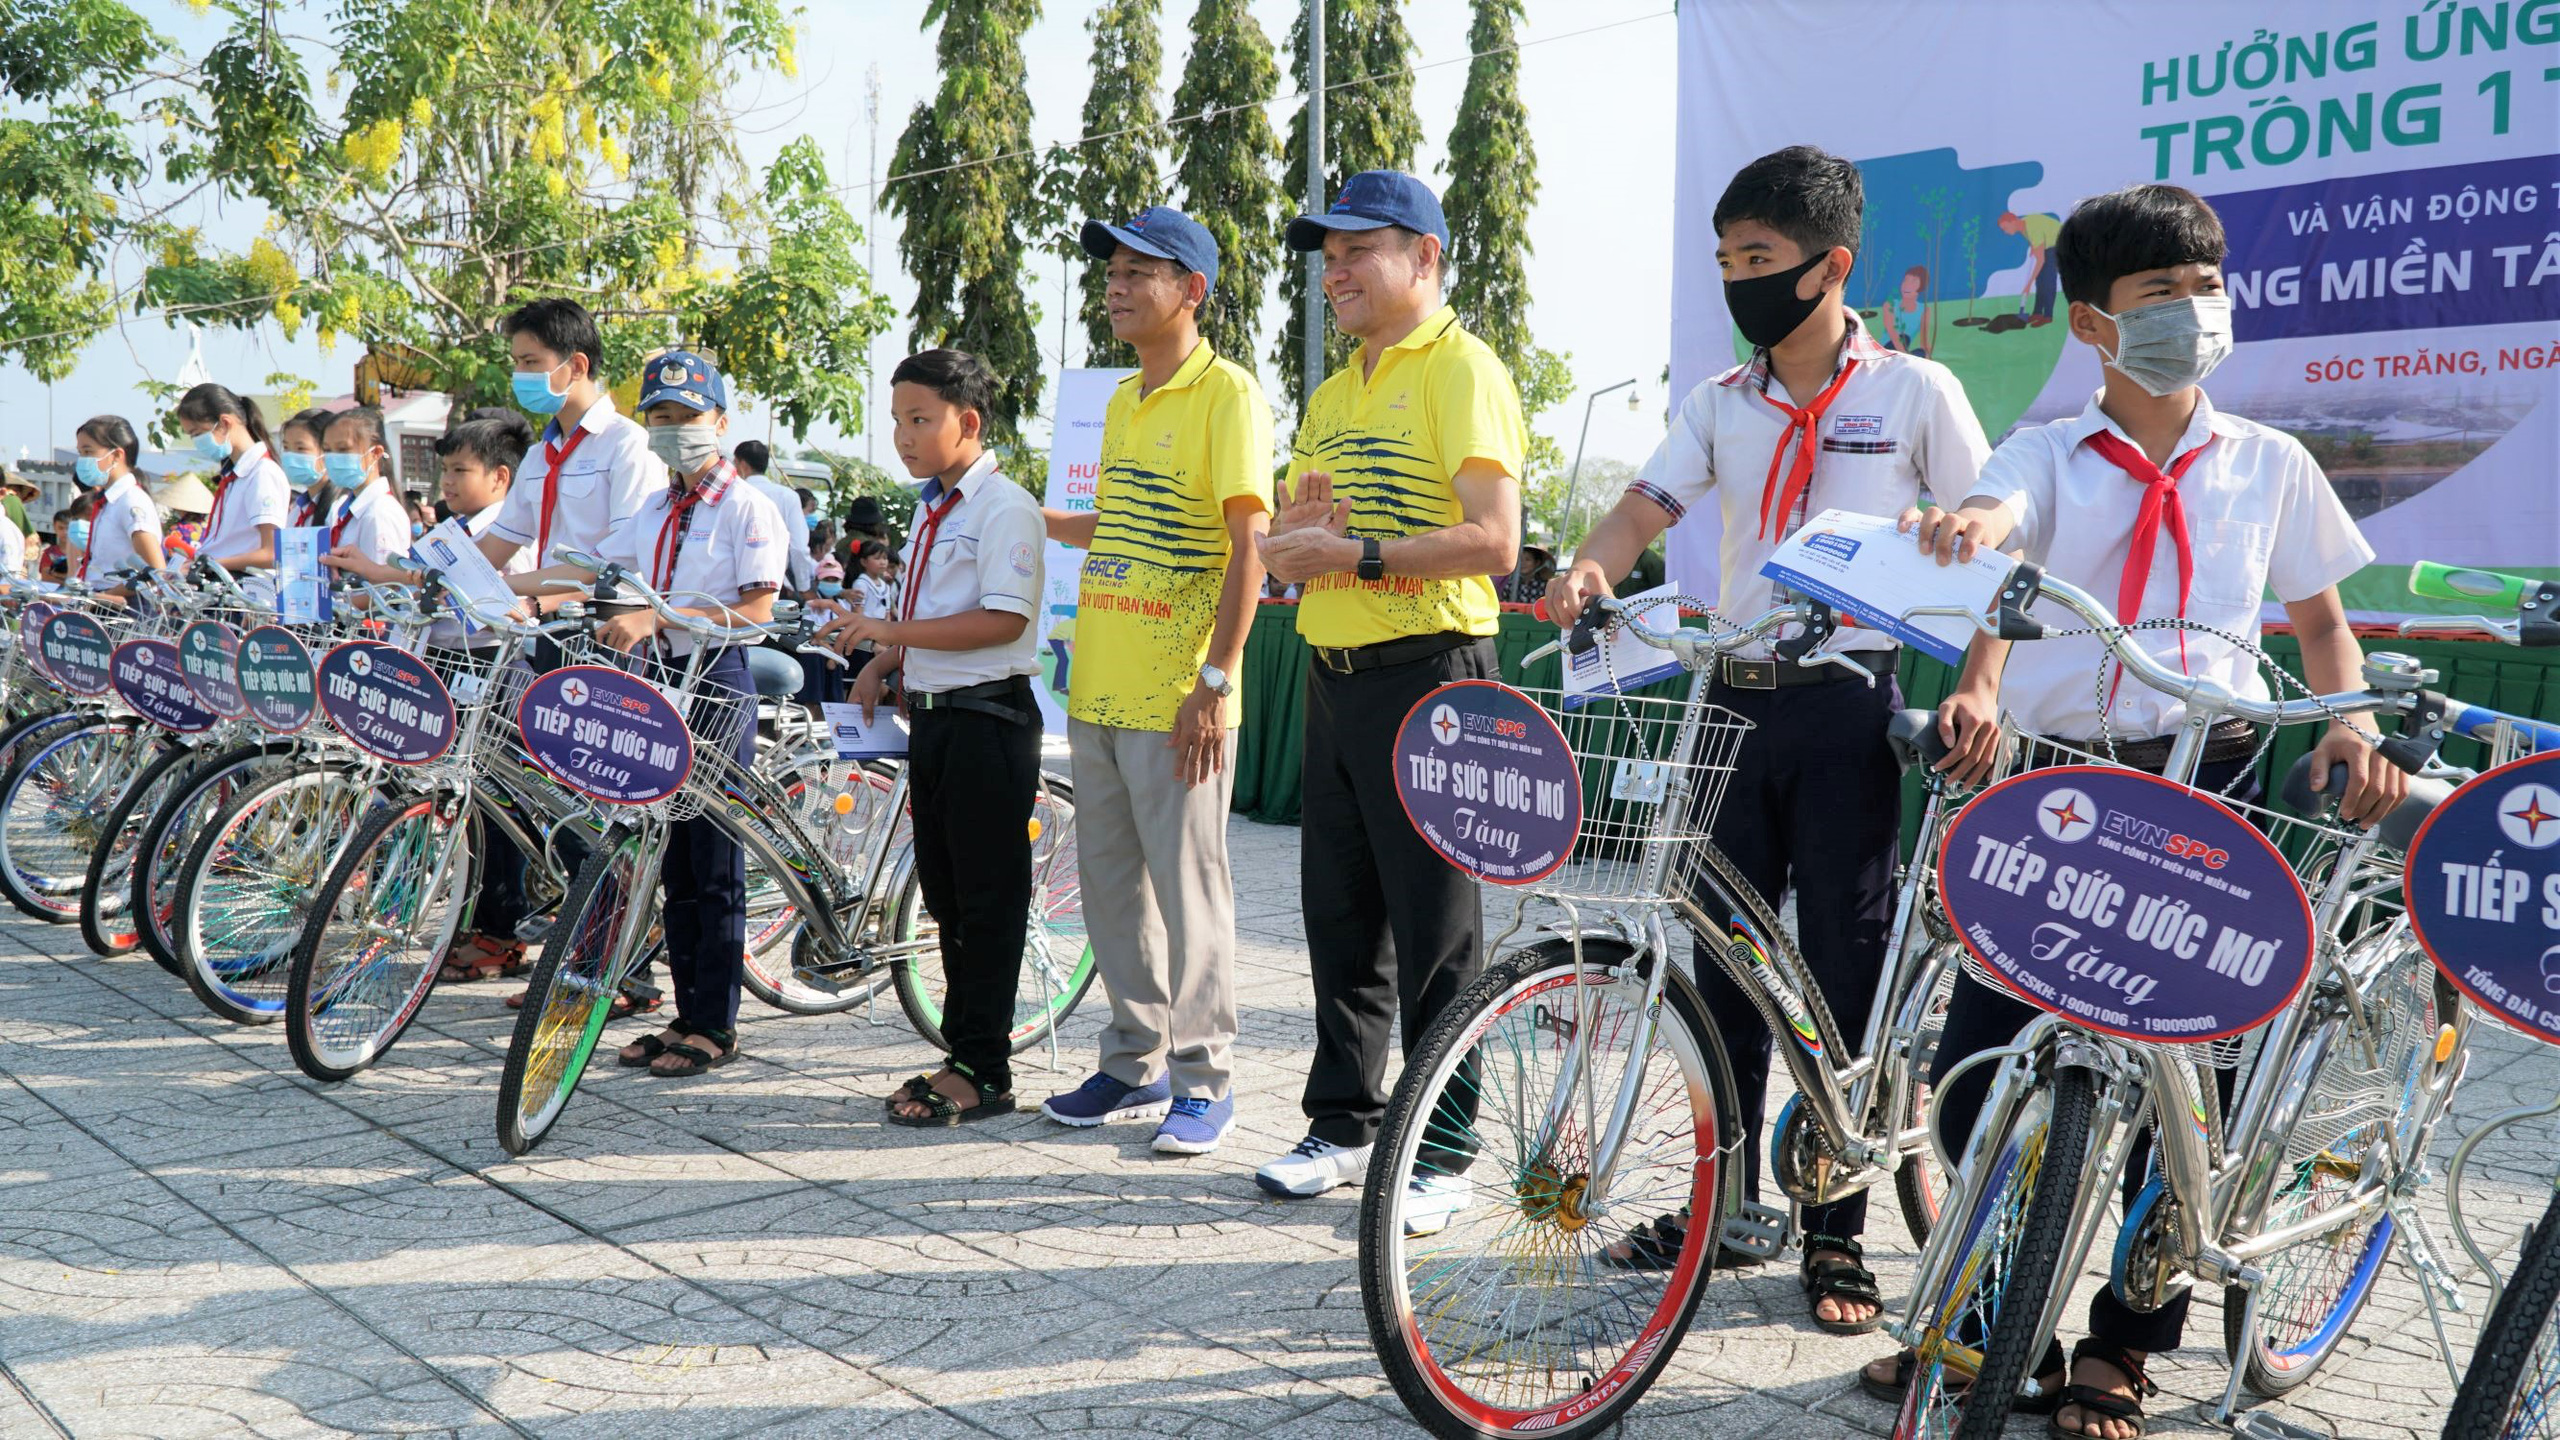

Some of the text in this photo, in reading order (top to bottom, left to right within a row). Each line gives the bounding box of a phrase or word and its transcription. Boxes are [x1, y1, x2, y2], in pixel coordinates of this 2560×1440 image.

[2141, 21, 2378, 107] HƯỞNG
[2139, 70, 2513, 181] TRỒNG 1
[2287, 202, 2329, 237] VÀ
[2341, 194, 2414, 234] VẬN
[2426, 184, 2538, 225] ĐỘNG
[2320, 237, 2473, 302] MIỀN
[2492, 231, 2560, 288] TÂ
[2304, 355, 2365, 384] SÓC
[2373, 347, 2488, 379] TRĂNG,
[1093, 592, 1116, 614] VƯỢT
[46, 639, 62, 659] TIẾP
[64, 643, 80, 663] SỨC
[81, 647, 98, 668] ƯỚC
[185, 651, 203, 675] TIẾP
[204, 658, 221, 681] SỨC
[373, 660, 421, 686] EVNSPC
[66, 664, 95, 687] Tặng
[119, 662, 143, 685] TIẾP
[143, 671, 167, 695] SỨC
[168, 682, 193, 706] ƯỚC
[206, 682, 235, 708] Tặng
[242, 665, 312, 693] TIẾP SỨC ƯỚC MƠ
[142, 693, 183, 721] Tặng
[264, 695, 295, 718] Tặng
[328, 671, 445, 738] TIẾP SỨC ƯỚC MƠ
[592, 686, 650, 715] EVNSPC
[356, 712, 406, 750] Tặng
[534, 703, 680, 772] TIẾP SỨC ƯỚC MƠ
[1463, 712, 1526, 738] EVNSPC
[1463, 733, 1477, 743] TỔNG
[1477, 735, 1490, 747] CÔNG
[1491, 738, 1498, 747] TY
[1531, 747, 1543, 756] NAM
[569, 747, 631, 787] Tặng
[1409, 746, 1565, 821] TIẾP SỨC ƯỚC MƠ
[747, 817, 795, 859] maxtin
[1423, 820, 1554, 877] TỔNG ĐÀI CSKH: 19001006 19009000
[1453, 806, 1522, 859] Tặng
[2102, 809, 2230, 870] EVNSPC
[2097, 835, 2252, 901] TỔNG CÔNG TY ĐIỆN LỰC MIỀN NAM
[2441, 849, 2531, 924] TIẾP
[1968, 834, 2284, 988] TIẾP SỨC ƯỚC MƠ
[1967, 921, 2217, 1033] TỔNG ĐÀI CSKH: 19001006 19009000
[2030, 920, 2160, 1006] Tặng
[2463, 964, 2507, 1003] TỔNG
[2504, 993, 2538, 1021] ĐÀI
[1566, 1380, 1621, 1417] CENFA
